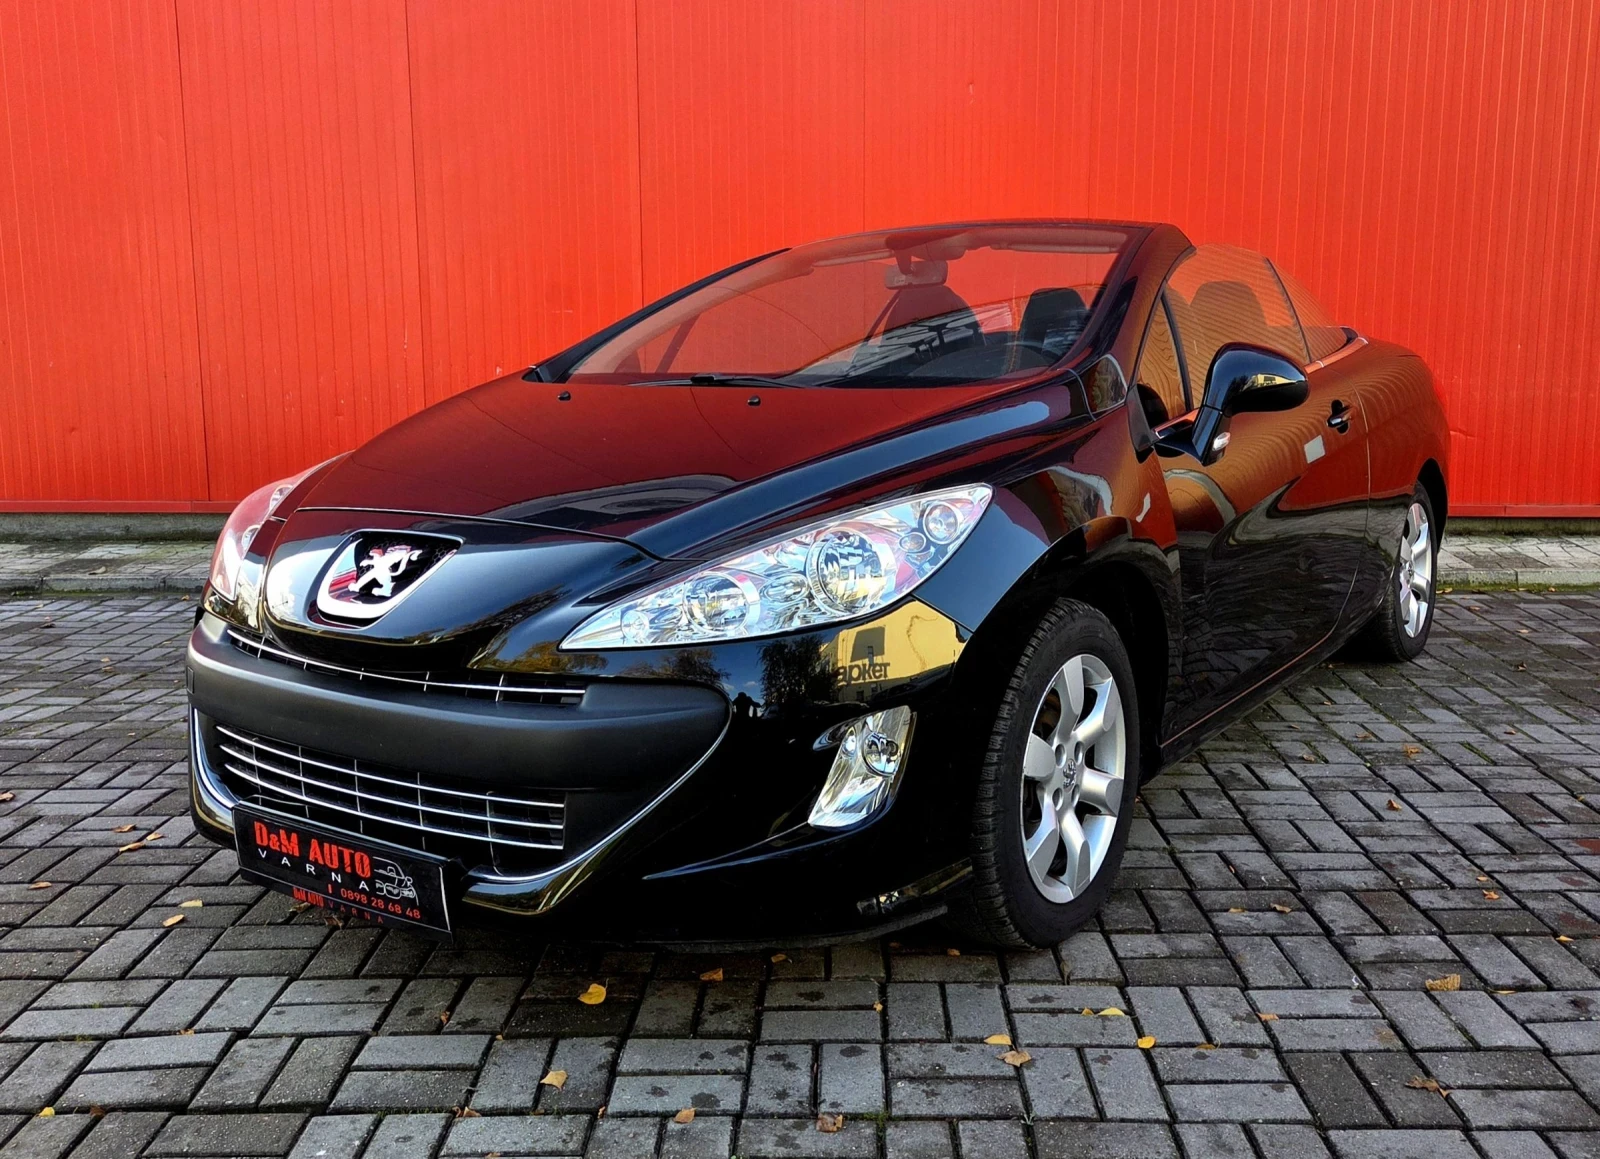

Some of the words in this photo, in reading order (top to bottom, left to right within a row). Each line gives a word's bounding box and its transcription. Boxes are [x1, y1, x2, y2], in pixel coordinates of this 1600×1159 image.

[254, 820, 300, 857] D&M
[309, 838, 371, 878] AUTO
[340, 888, 368, 904] 0898
[371, 897, 385, 909] 28
[388, 903, 402, 914] 68
[405, 908, 421, 920] 48
